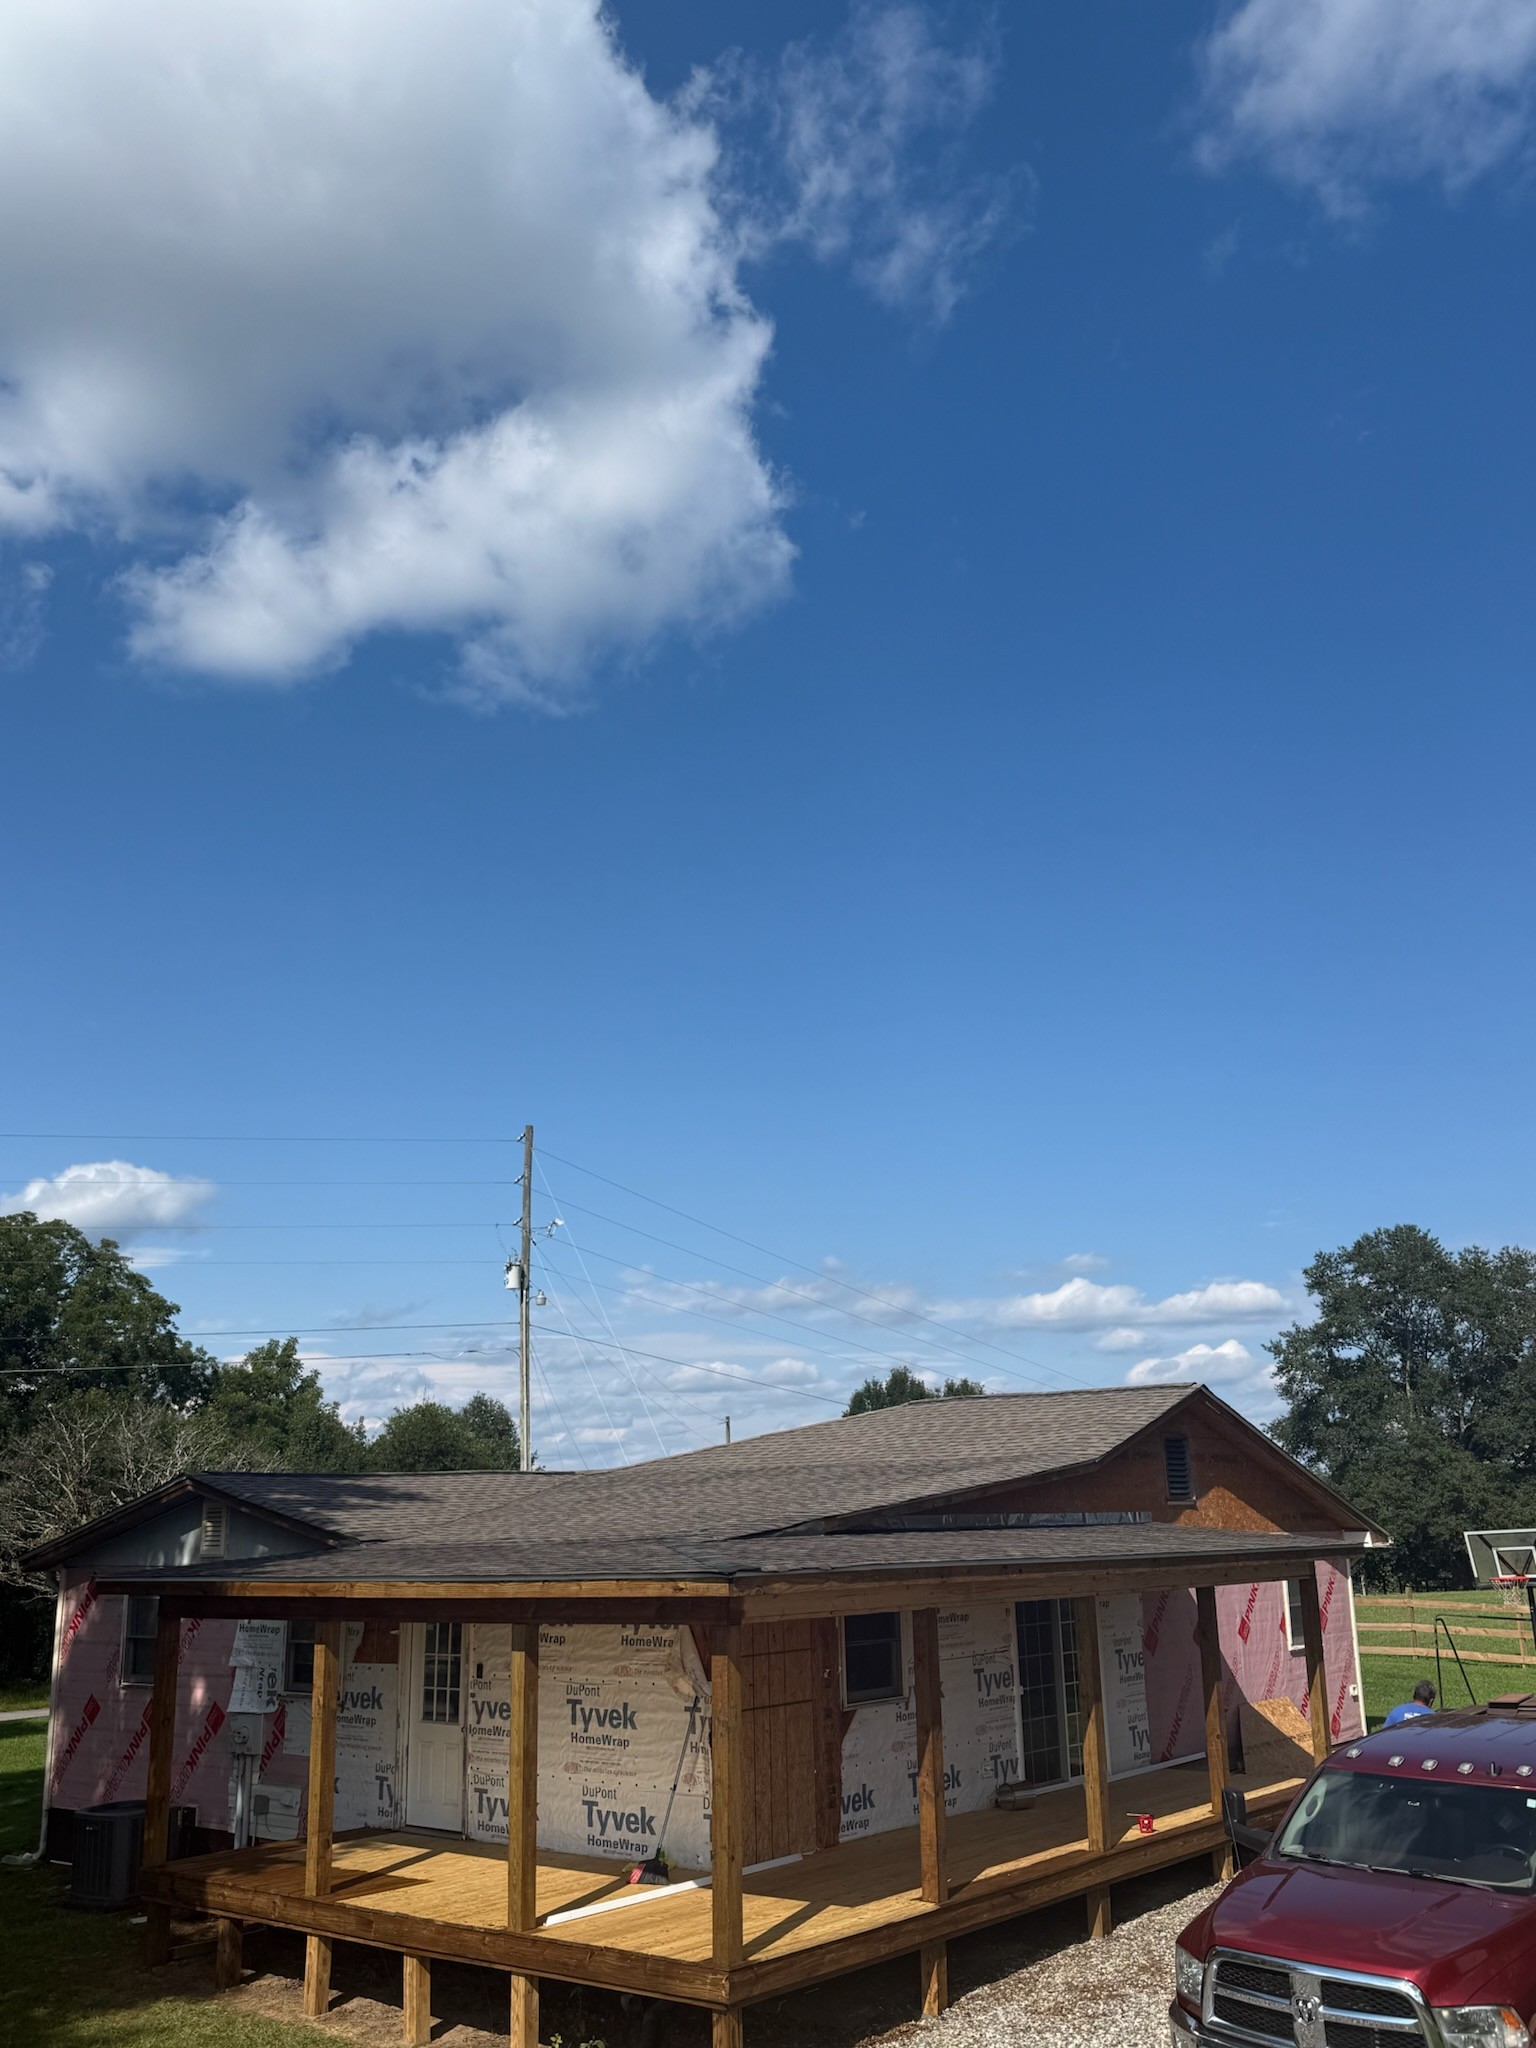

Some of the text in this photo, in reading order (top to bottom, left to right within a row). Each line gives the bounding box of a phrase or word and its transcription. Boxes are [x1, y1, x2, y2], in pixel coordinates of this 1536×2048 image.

[938, 1612, 970, 1624] meWrap
[239, 1623, 281, 1636] HomeWrap
[540, 1632, 566, 1646] Wrap
[621, 1635, 674, 1648] HomeWra
[972, 1654, 996, 1666] DuPont
[1115, 1649, 1144, 1674] Tyve
[470, 1679, 492, 1690] Pont
[1119, 1673, 1144, 1684] HomeWr
[566, 1684, 600, 1697] DuPont
[337, 1686, 383, 1713] yvek
[472, 1699, 511, 1724] yve
[566, 1698, 638, 1733] Tyvek
[337, 1714, 377, 1728] omeWrap
[571, 1732, 630, 1749] HomeWrap
[988, 1740, 1012, 1752] DuPont
[990, 1755, 1019, 1783] Tyv
[473, 1774, 505, 1788] DuPont
[582, 1785, 617, 1800] DuPont
[474, 1787, 509, 1822] Tyv
[581, 1800, 656, 1836] Tyvek
[840, 1818, 870, 1833] eWrap
[477, 1819, 509, 1836] Home
[587, 1834, 648, 1855] HomeWrap
